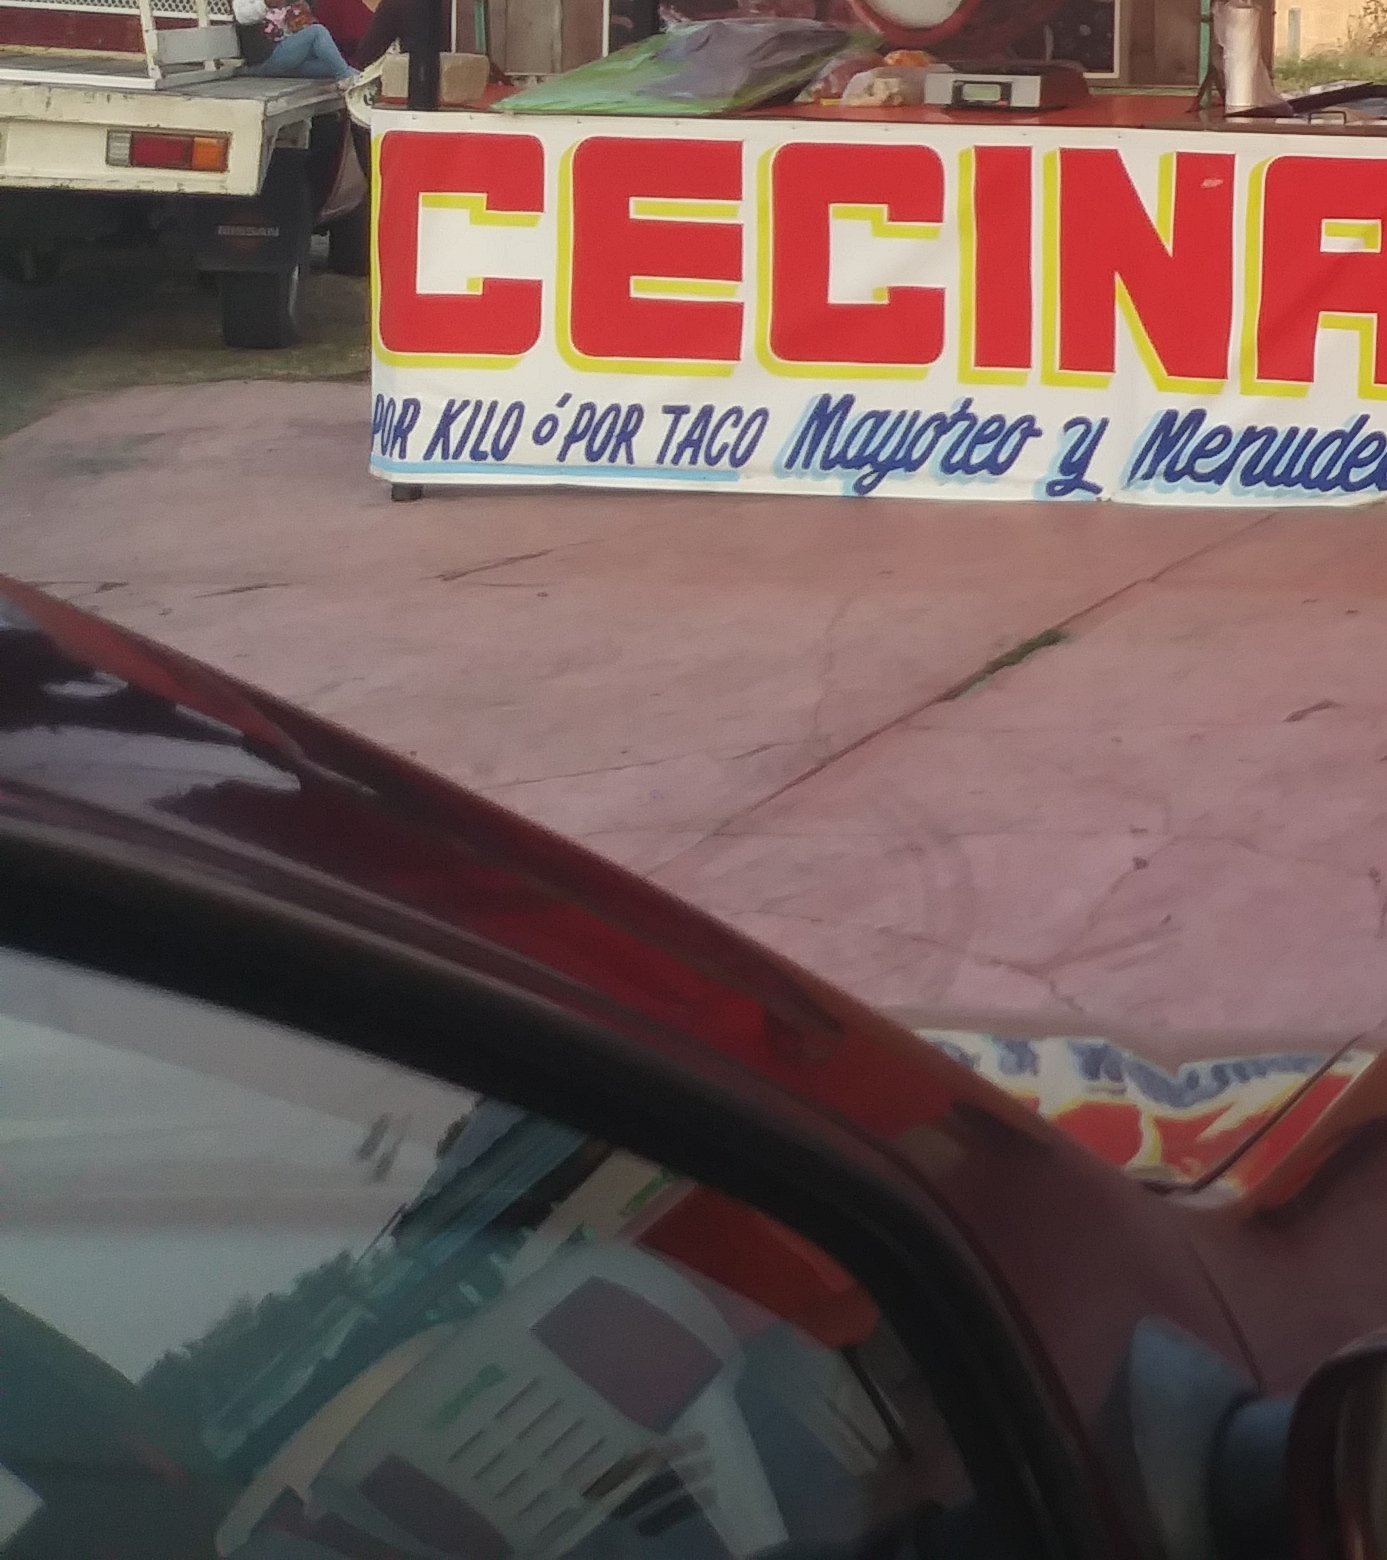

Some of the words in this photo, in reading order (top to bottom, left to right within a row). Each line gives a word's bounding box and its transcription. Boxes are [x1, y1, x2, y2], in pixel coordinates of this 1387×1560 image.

[373, 393, 421, 460] POR
[423, 398, 526, 462] KILO
[556, 401, 644, 466] POR
[656, 403, 770, 469] TACO
[784, 392, 1042, 496] Mayoreo
[1046, 415, 1110, 496] y
